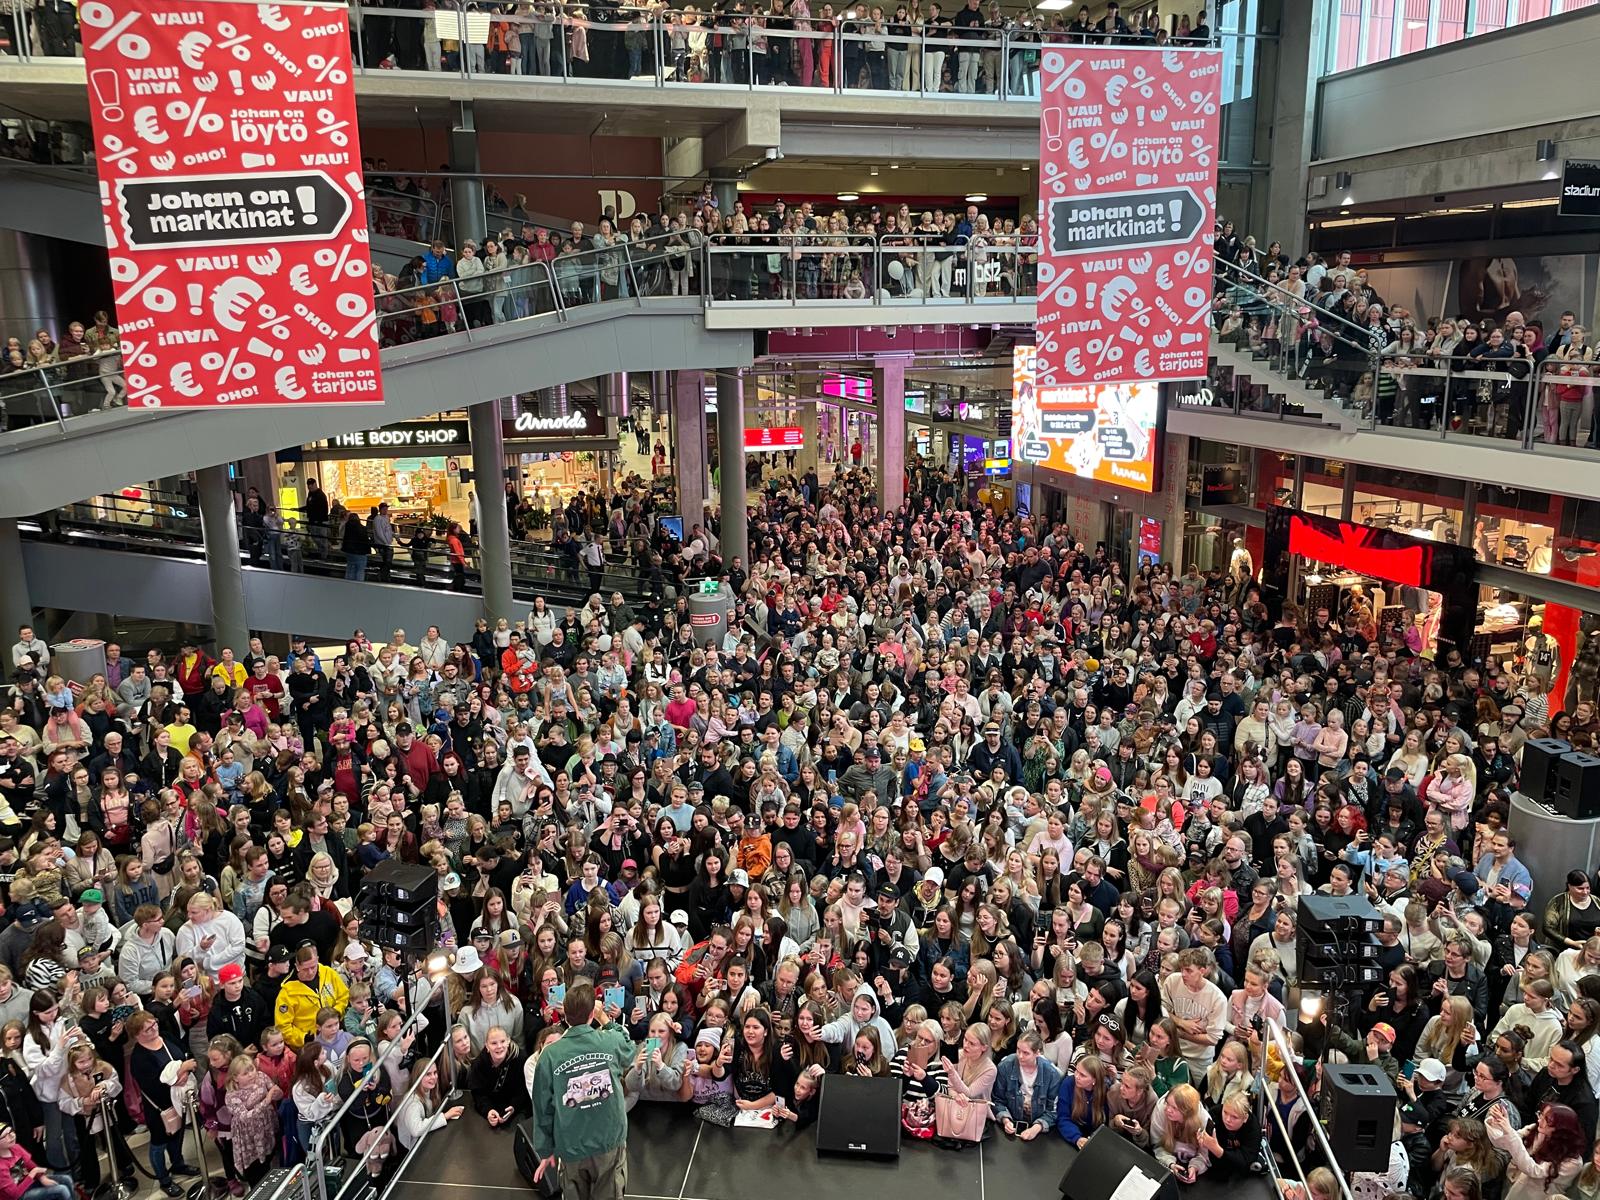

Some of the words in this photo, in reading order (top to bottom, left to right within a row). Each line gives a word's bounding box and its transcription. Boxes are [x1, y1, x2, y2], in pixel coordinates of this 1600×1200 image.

[152, 12, 203, 25] VAU!
[302, 22, 344, 38] OHO!
[264, 43, 302, 77] OHO!
[1090, 59, 1125, 70] VAU!
[127, 67, 179, 80] VAU!
[1190, 64, 1218, 78] OHO!
[284, 89, 332, 102] VAU!
[1163, 83, 1186, 110] OHO!
[230, 109, 280, 118] Johan
[1068, 104, 1102, 116] VAU!
[231, 119, 308, 146] löytö
[1171, 119, 1204, 131] VAU!
[1132, 137, 1166, 145] Johan
[184, 148, 226, 165] OHO!
[301, 153, 348, 165] VAU!
[1132, 144, 1183, 167] löytö
[1097, 171, 1126, 185] OHO!
[1176, 171, 1208, 182] VAU!
[1564, 184, 1600, 197] stadium
[147, 192, 243, 210] Johan
[250, 190, 289, 205] on
[150, 206, 295, 233] markkinat
[1069, 206, 1132, 222] Johan
[1137, 204, 1163, 216] on
[1069, 217, 1165, 241] markkinat
[176, 255, 238, 271] VAU!
[1082, 258, 1122, 272] VAU!
[1156, 296, 1182, 326] OHO!
[294, 304, 337, 339] OHO!
[1094, 366, 1122, 380] OHO!
[1159, 359, 1203, 371] tarjous
[217, 386, 258, 402] OHO!
[312, 379, 377, 395] tarjous
[515, 410, 587, 431] Arnolds
[336, 431, 364, 446] THE
[369, 430, 412, 445] BODY
[416, 429, 458, 443] SHOP
